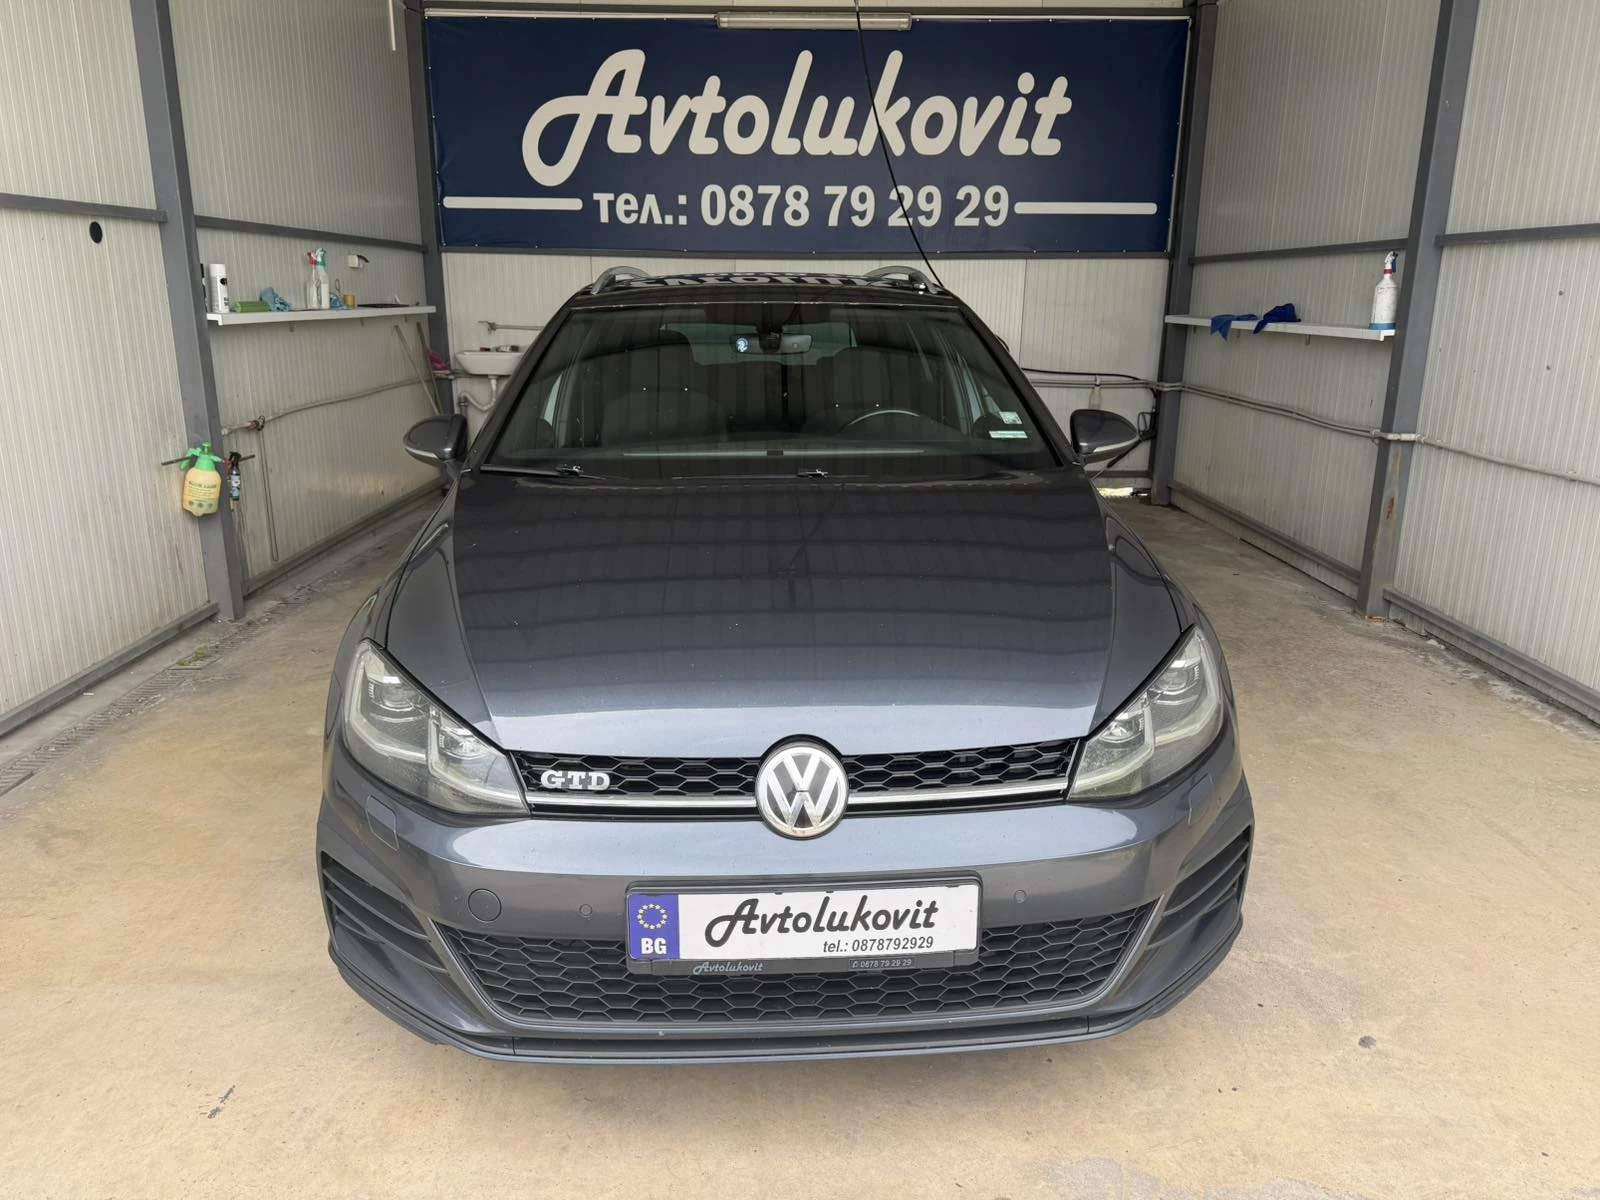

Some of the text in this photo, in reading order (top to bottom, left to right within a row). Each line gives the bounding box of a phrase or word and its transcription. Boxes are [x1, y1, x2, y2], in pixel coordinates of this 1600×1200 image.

[522, 48, 1072, 187] Avtolukovit
[593, 184, 1009, 227] тел.: 0878 79 29 29
[540, 769, 611, 791] GTD
[704, 894, 939, 948] Avtolukovit
[641, 937, 667, 955] BG
[823, 936, 934, 953] tel.: 0878792929
[692, 961, 764, 976] Avtolukovit
